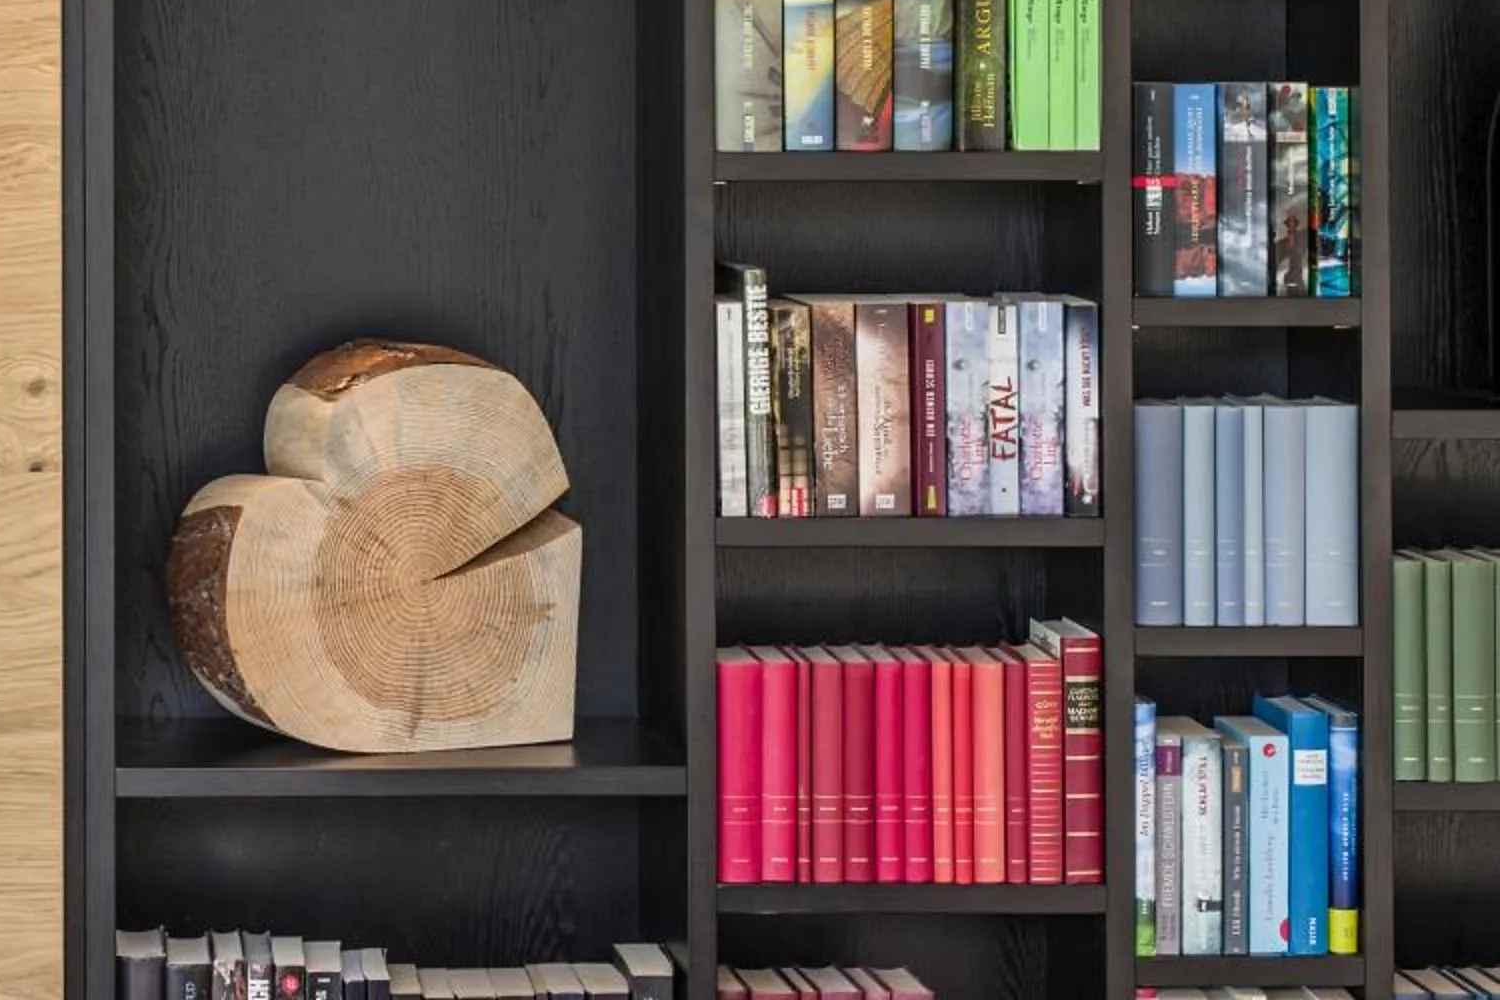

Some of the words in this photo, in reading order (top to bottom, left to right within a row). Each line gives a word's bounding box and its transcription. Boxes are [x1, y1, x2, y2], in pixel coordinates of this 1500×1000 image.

[983, 73, 995, 127] Hoffman
[747, 284, 767, 342] BESTIE
[747, 348, 770, 414] GIERIGE
[991, 376, 1016, 460] FATAL
